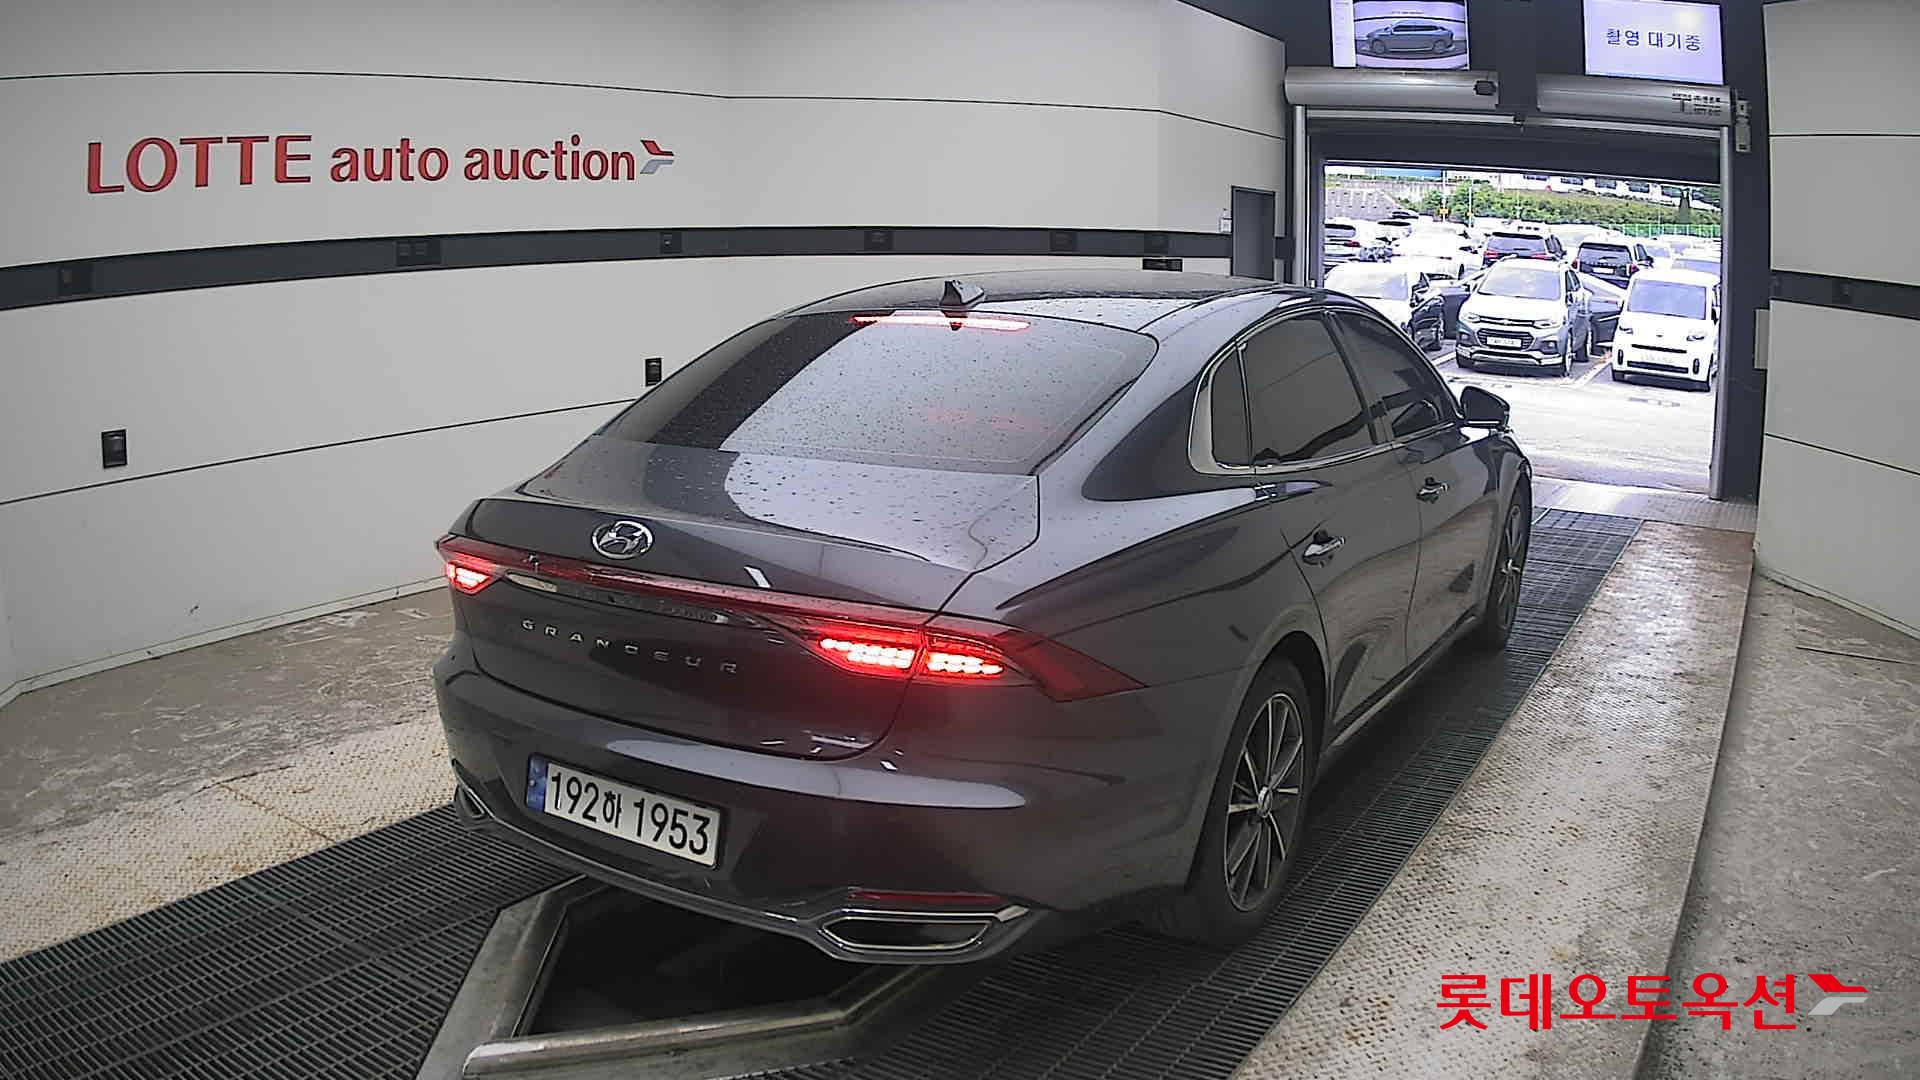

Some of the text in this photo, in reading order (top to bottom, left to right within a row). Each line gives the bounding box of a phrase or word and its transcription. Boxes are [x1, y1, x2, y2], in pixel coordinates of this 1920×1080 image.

[1607, 28, 1701, 52] 촬영 대기중
[87, 133, 636, 194] LOTTE auto auction
[521, 618, 738, 674] GRANDEUR
[551, 772, 711, 856] 192하 1953
